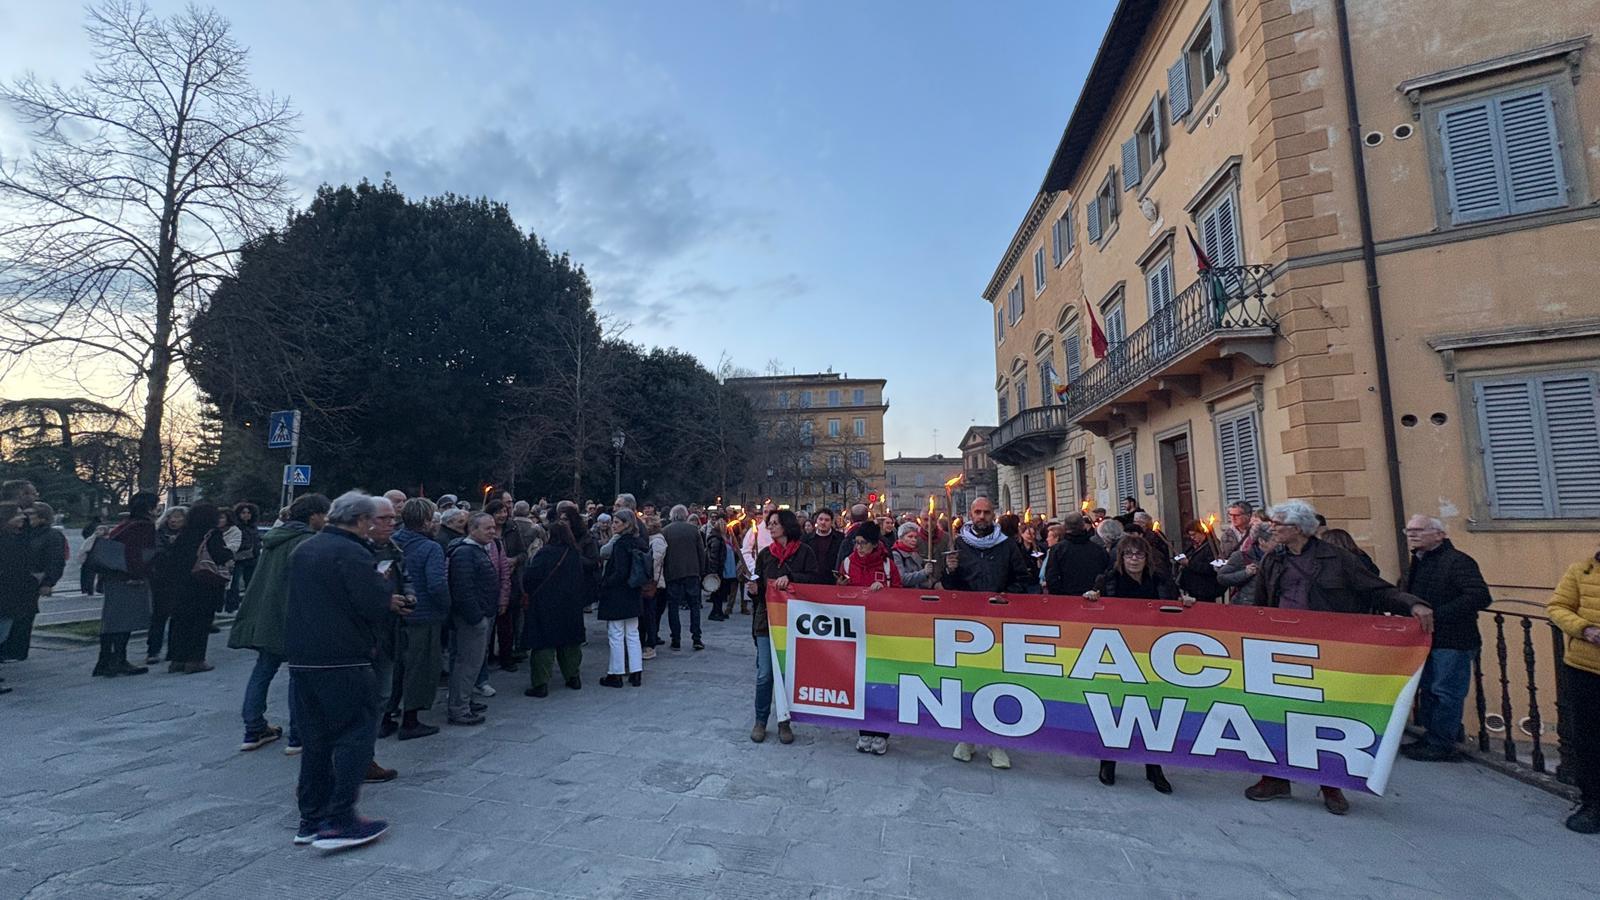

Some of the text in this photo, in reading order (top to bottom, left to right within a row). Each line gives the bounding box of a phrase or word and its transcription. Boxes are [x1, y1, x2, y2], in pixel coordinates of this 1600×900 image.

[796, 614, 857, 638] CGIL
[933, 618, 1324, 703] PEACE
[798, 686, 850, 705] SIENA
[898, 673, 1376, 778] NO WAR
